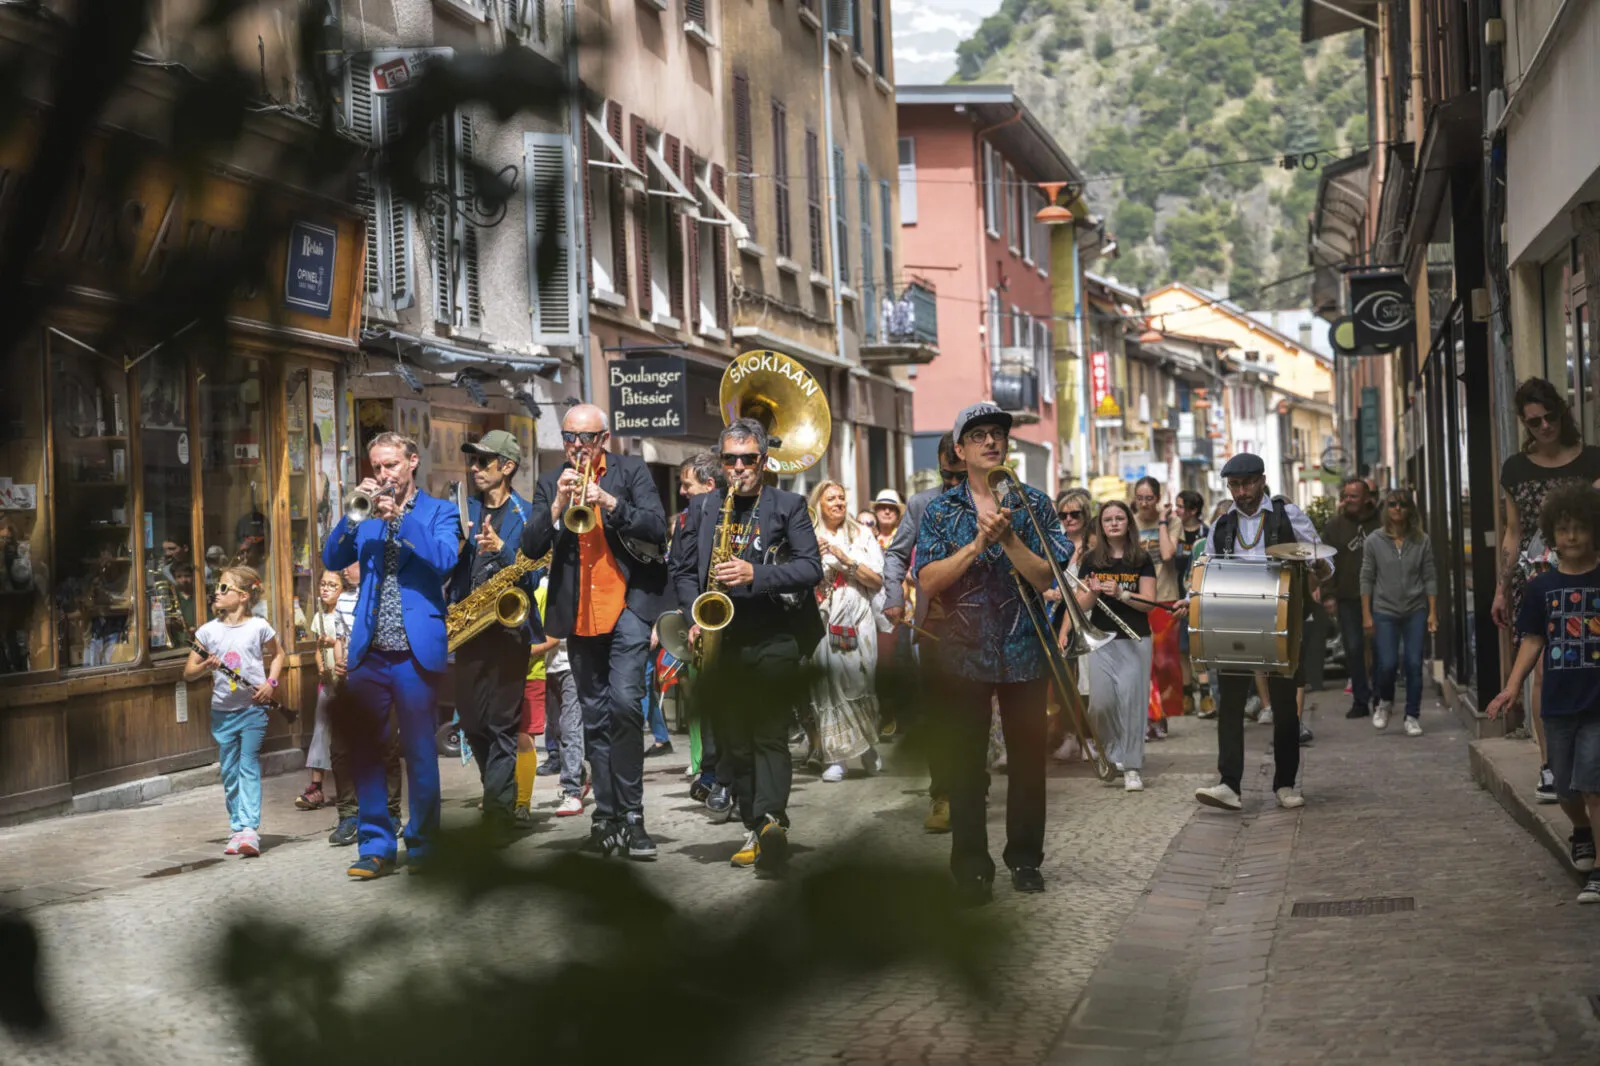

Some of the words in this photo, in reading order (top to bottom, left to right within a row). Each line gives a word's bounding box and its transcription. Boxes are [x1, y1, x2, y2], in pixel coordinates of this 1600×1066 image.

[297, 268, 318, 284] OPINEL
[611, 366, 682, 388] Boulanger
[730, 355, 818, 397] SKOKIAAN
[1093, 354, 1106, 407] HOTE
[313, 387, 334, 401] CUISINE
[621, 386, 672, 406] Pâtissier
[614, 411, 649, 431] Pause
[652, 409, 680, 427] café
[781, 454, 815, 471] BAND
